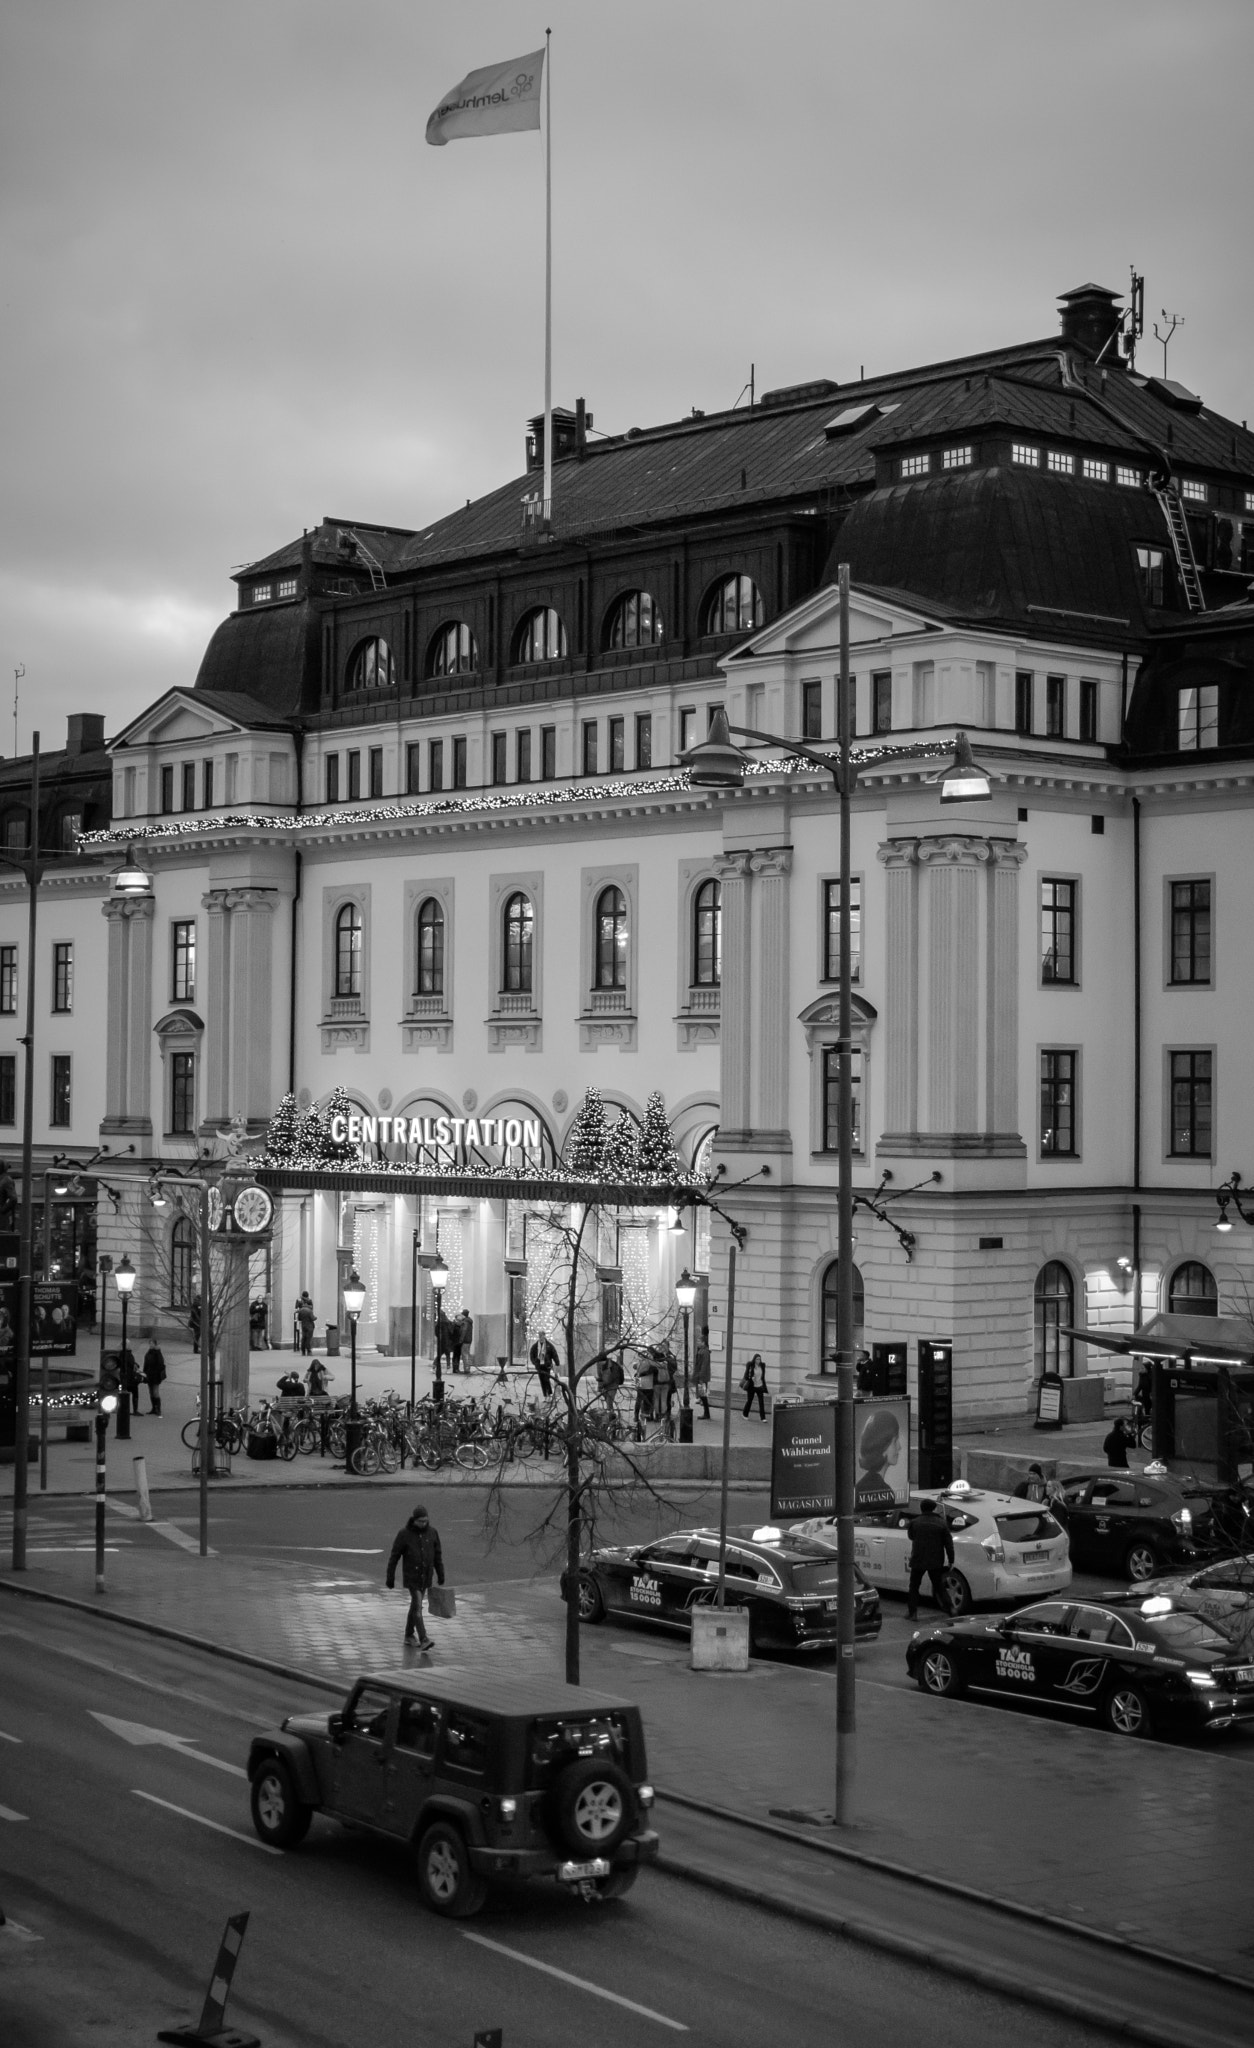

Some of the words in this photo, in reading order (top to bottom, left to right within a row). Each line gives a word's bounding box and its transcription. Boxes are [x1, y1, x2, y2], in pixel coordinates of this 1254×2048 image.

[331, 1115, 540, 1147] CENTRALSTATION
[791, 1434, 822, 1445] Gunnel
[858, 1490, 895, 1503] MAGASIN
[777, 1498, 823, 1510] MAGASIN
[824, 1497, 833, 1507] III
[632, 1575, 658, 1591] TAXI
[630, 1586, 661, 1597] STOCKHOLM
[998, 1647, 1031, 1665] TAXI
[995, 1659, 1035, 1672] STOCKHOLM
